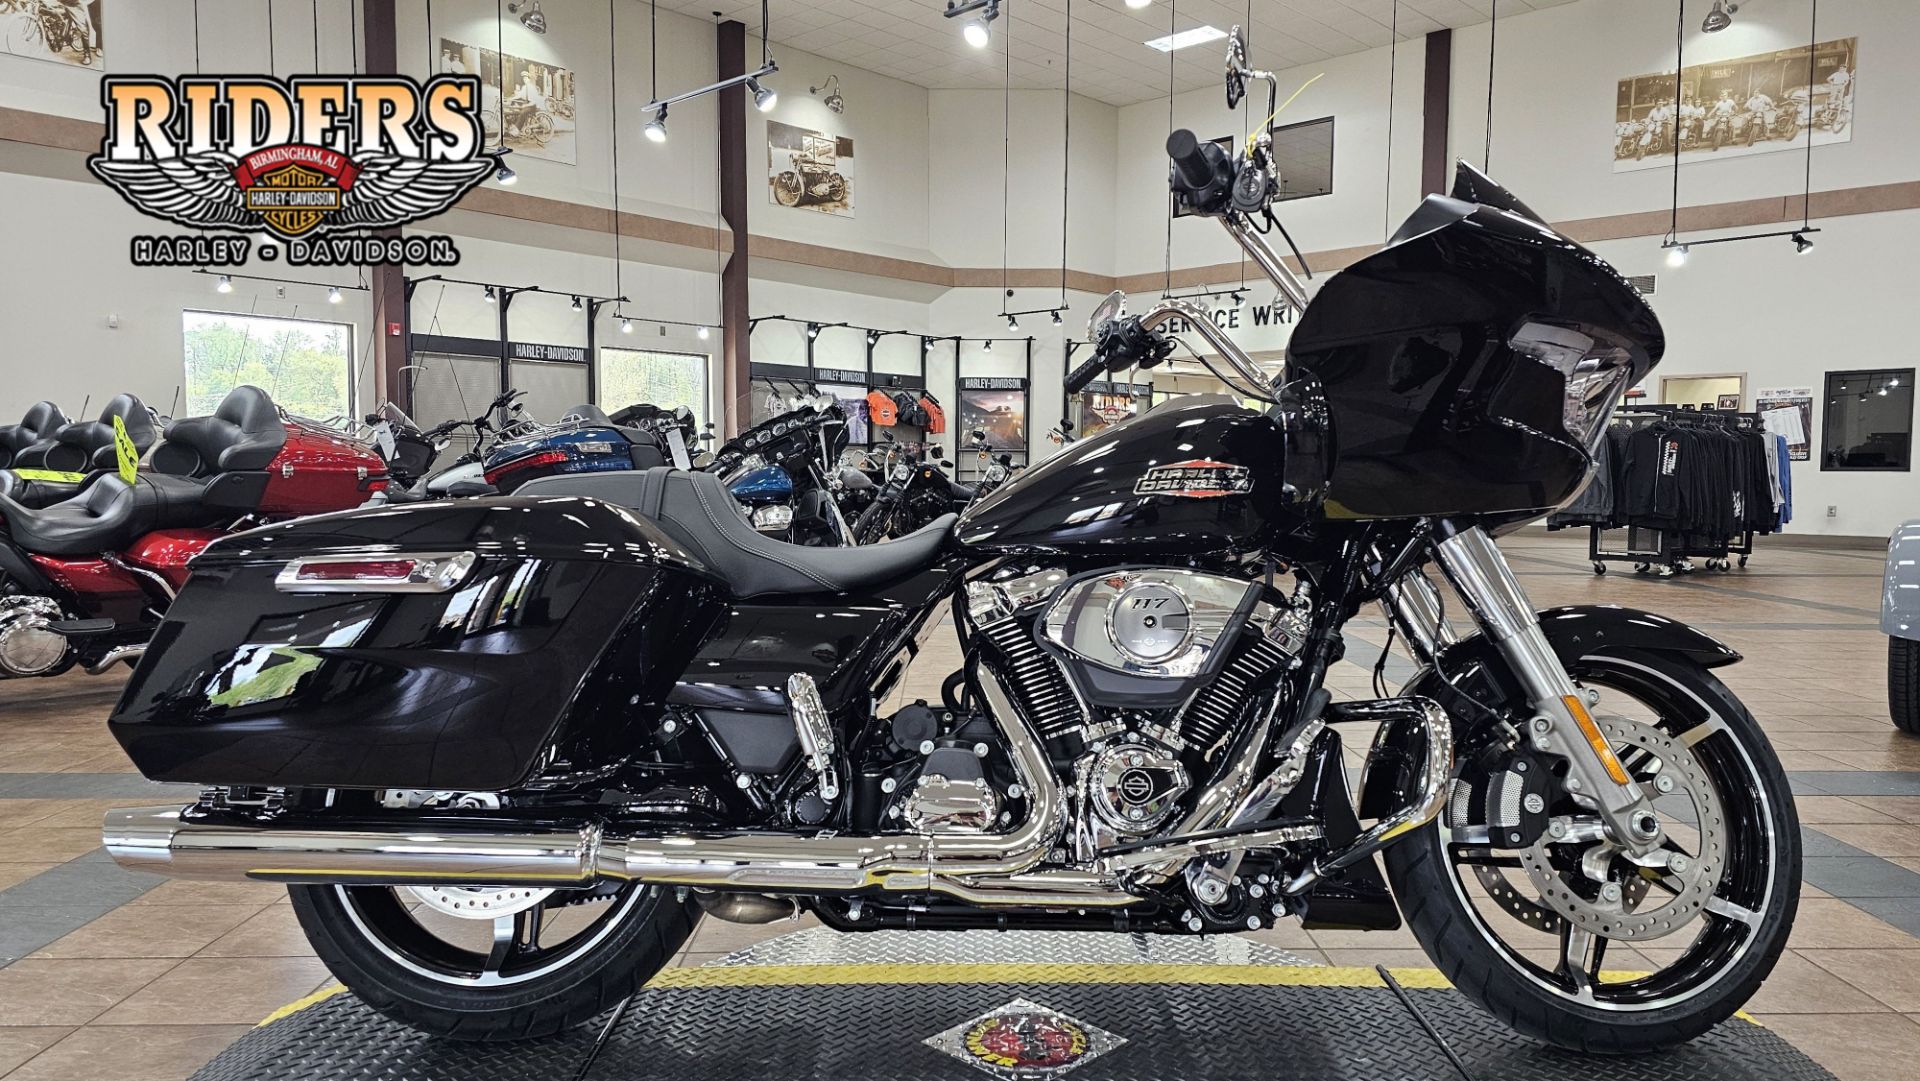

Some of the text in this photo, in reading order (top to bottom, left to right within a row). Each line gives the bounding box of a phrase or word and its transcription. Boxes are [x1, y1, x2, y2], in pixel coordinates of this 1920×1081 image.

[1157, 304, 1301, 334] SERCE WRI
[515, 343, 585, 362] HARLEY-DAVIDSON
[965, 377, 1021, 389] HARLEY-DAVIDSON
[1150, 467, 1246, 480] HARL
[1132, 597, 1171, 609] 117
